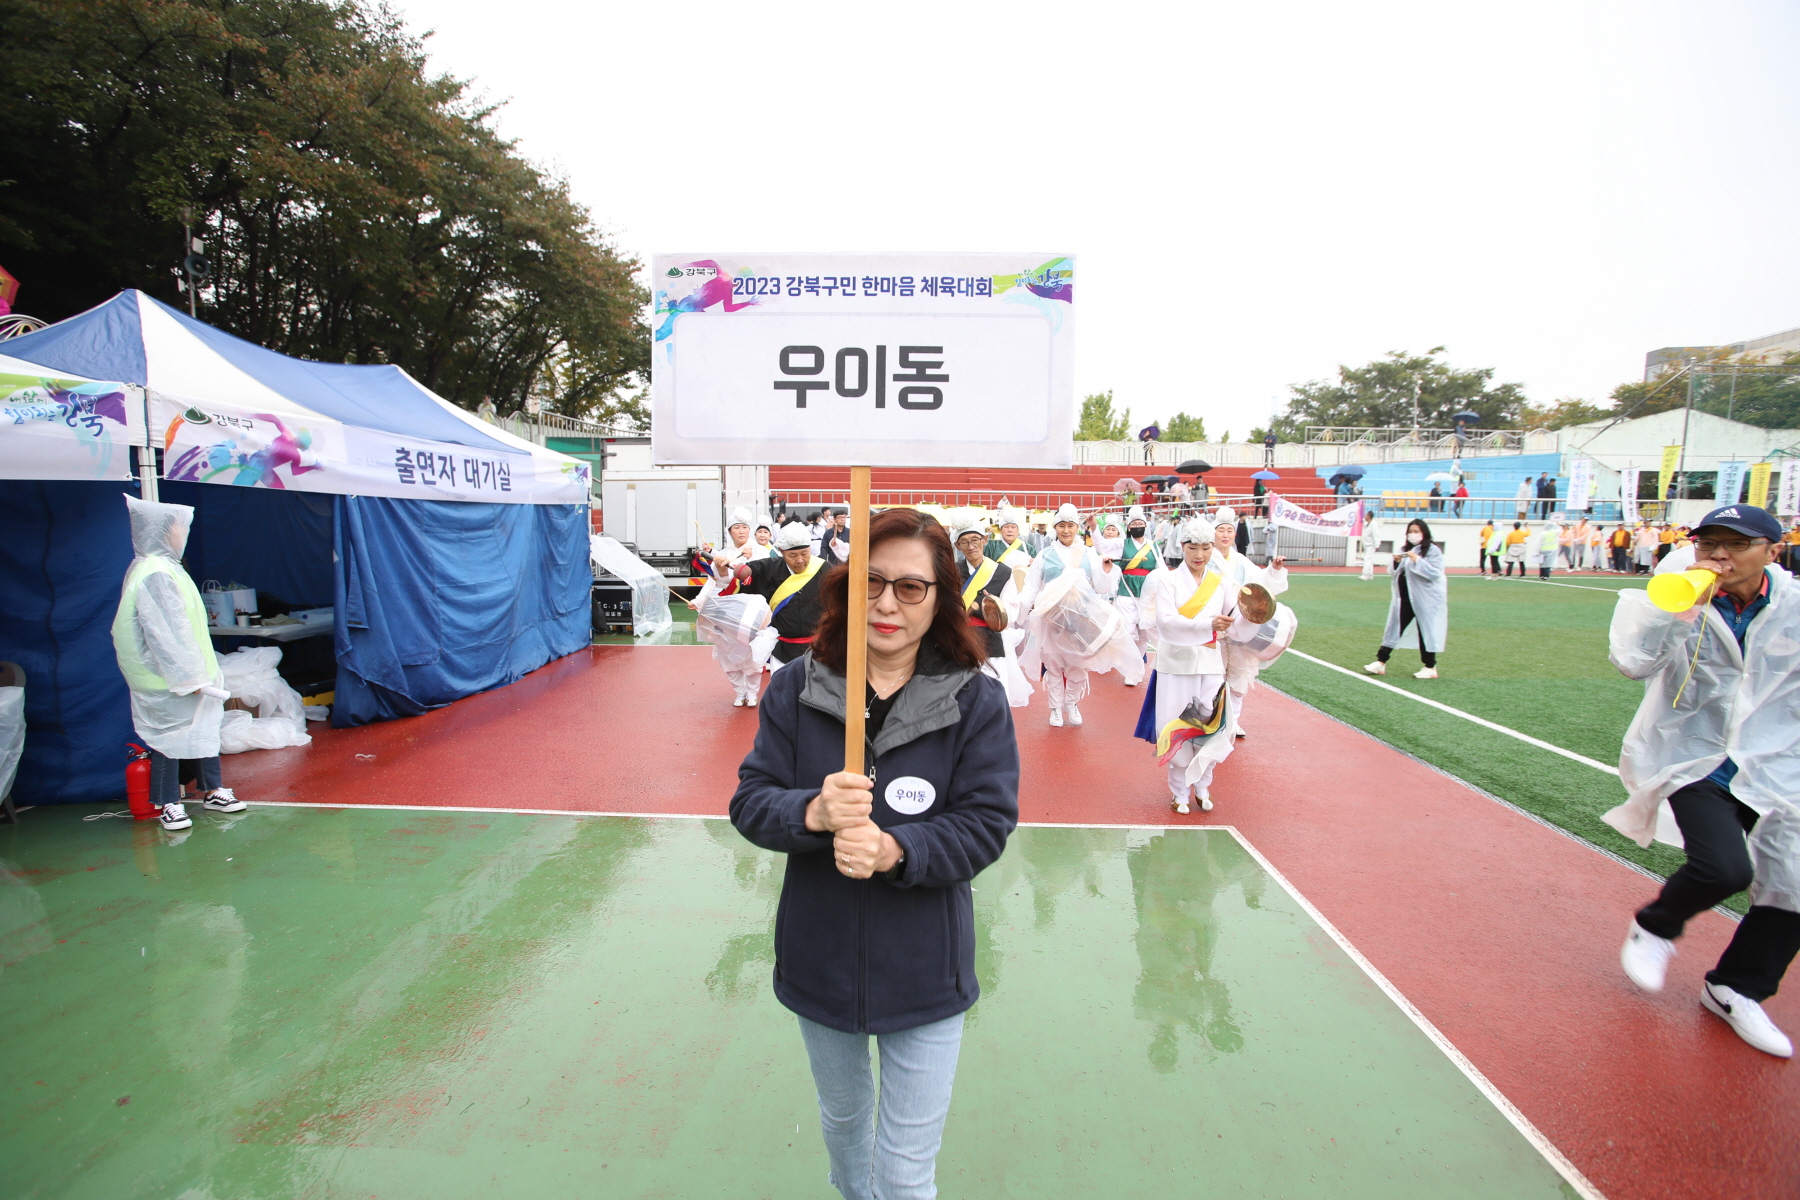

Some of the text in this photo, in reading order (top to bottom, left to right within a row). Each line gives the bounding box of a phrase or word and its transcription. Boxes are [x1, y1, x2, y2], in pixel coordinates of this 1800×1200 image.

[686, 268, 716, 277] 강북구
[1038, 268, 1063, 292] 강북
[733, 276, 993, 298] 2023 강북구민 한마음 체육대회
[773, 345, 950, 410] 우이동
[56, 392, 104, 437] 강북
[212, 413, 253, 431] 강북구
[395, 447, 512, 492] 출연자 대기실
[895, 789, 926, 803] 우이동
